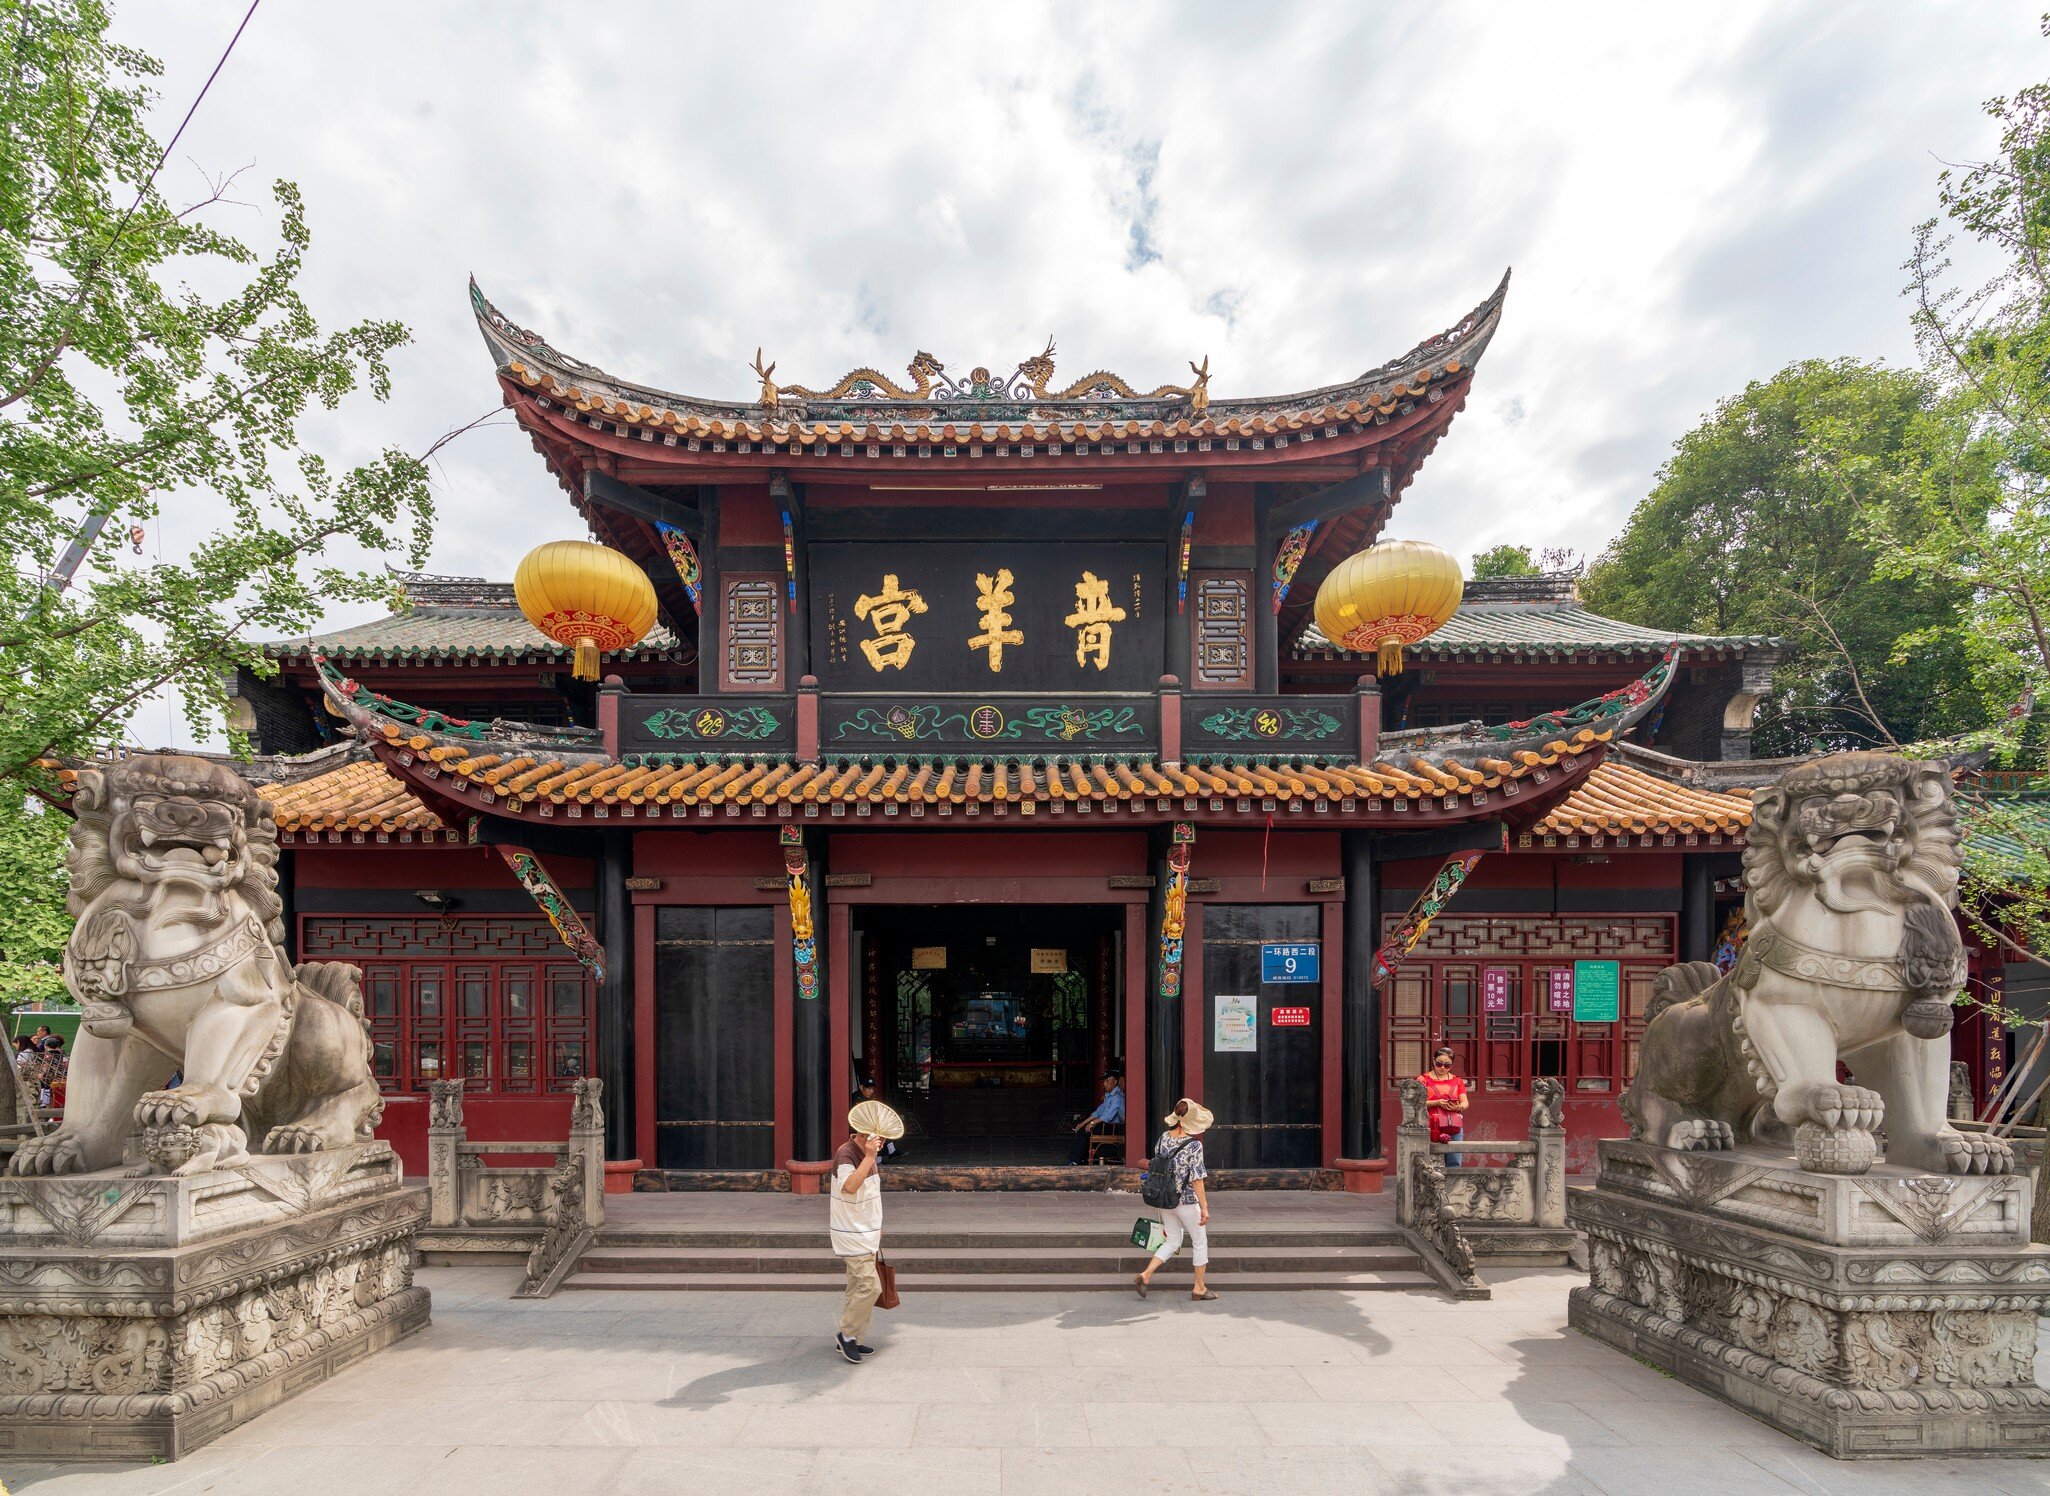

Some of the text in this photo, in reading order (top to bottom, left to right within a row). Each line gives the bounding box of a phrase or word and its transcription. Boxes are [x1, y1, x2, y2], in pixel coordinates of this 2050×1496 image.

[1265, 947, 1316, 956] 一环路西二段
[1285, 957, 1297, 973] 9
[1487, 973, 1495, 1008] 门票10元
[1496, 975, 1504, 1005] 售票处
[1553, 972, 1562, 1008] 请勿喧哗
[1562, 972, 1571, 1008] 清静之地
